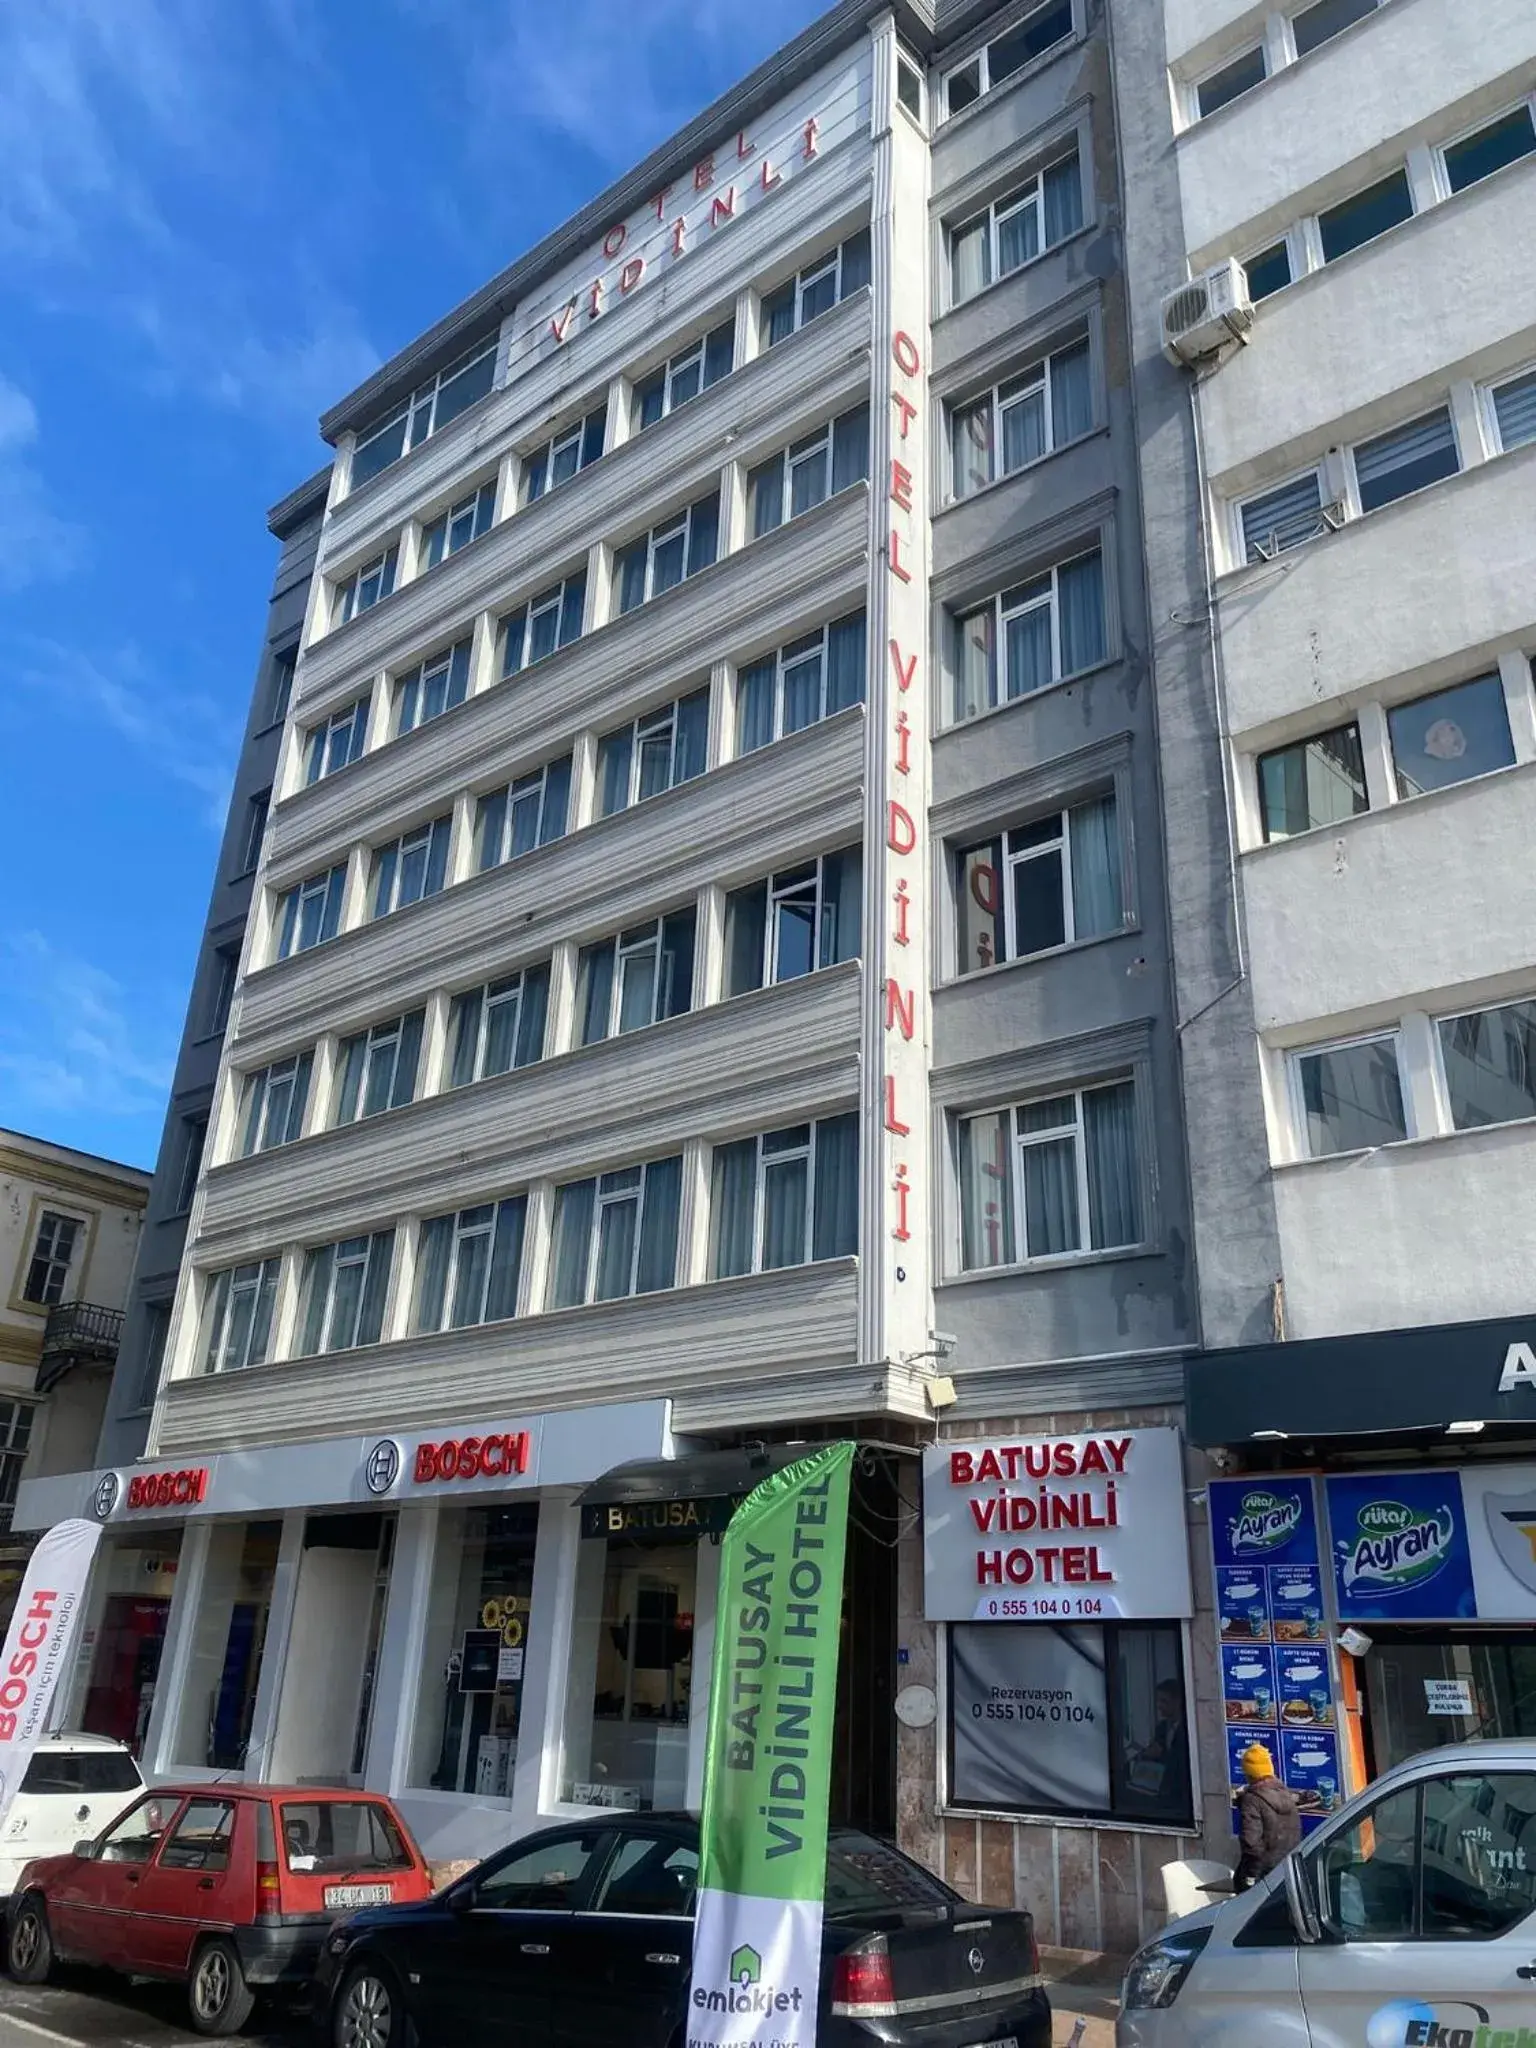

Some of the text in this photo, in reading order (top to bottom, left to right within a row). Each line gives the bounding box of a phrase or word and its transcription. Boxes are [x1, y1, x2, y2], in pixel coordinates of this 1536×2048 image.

[604, 131, 756, 258] OTEL
[889, 331, 919, 585] OTEL
[413, 1430, 531, 1483] BOSCH
[950, 1437, 1133, 1485] BATUSAY
[126, 1467, 208, 1509] BOSCH
[970, 1480, 1119, 1533] VİDİNLİ
[1239, 1505, 1294, 1541] Ayran
[1355, 1522, 1440, 1575] Ayran
[976, 1546, 1114, 1585] HOTEL
[989, 1598, 1102, 1615] 0 555 104 0 104
[0, 1591, 58, 1742] BOSCH
[18, 1592, 76, 1742] Yaşam için teknoloji
[728, 1542, 775, 1771] BATUSAY
[759, 1472, 832, 1860] VİDİNLİ HOTEL
[972, 1703, 1095, 1723] 0 555 104 0 104
[991, 1686, 1073, 1703] Rezervasyon
[693, 1986, 802, 2018] emlakjet
